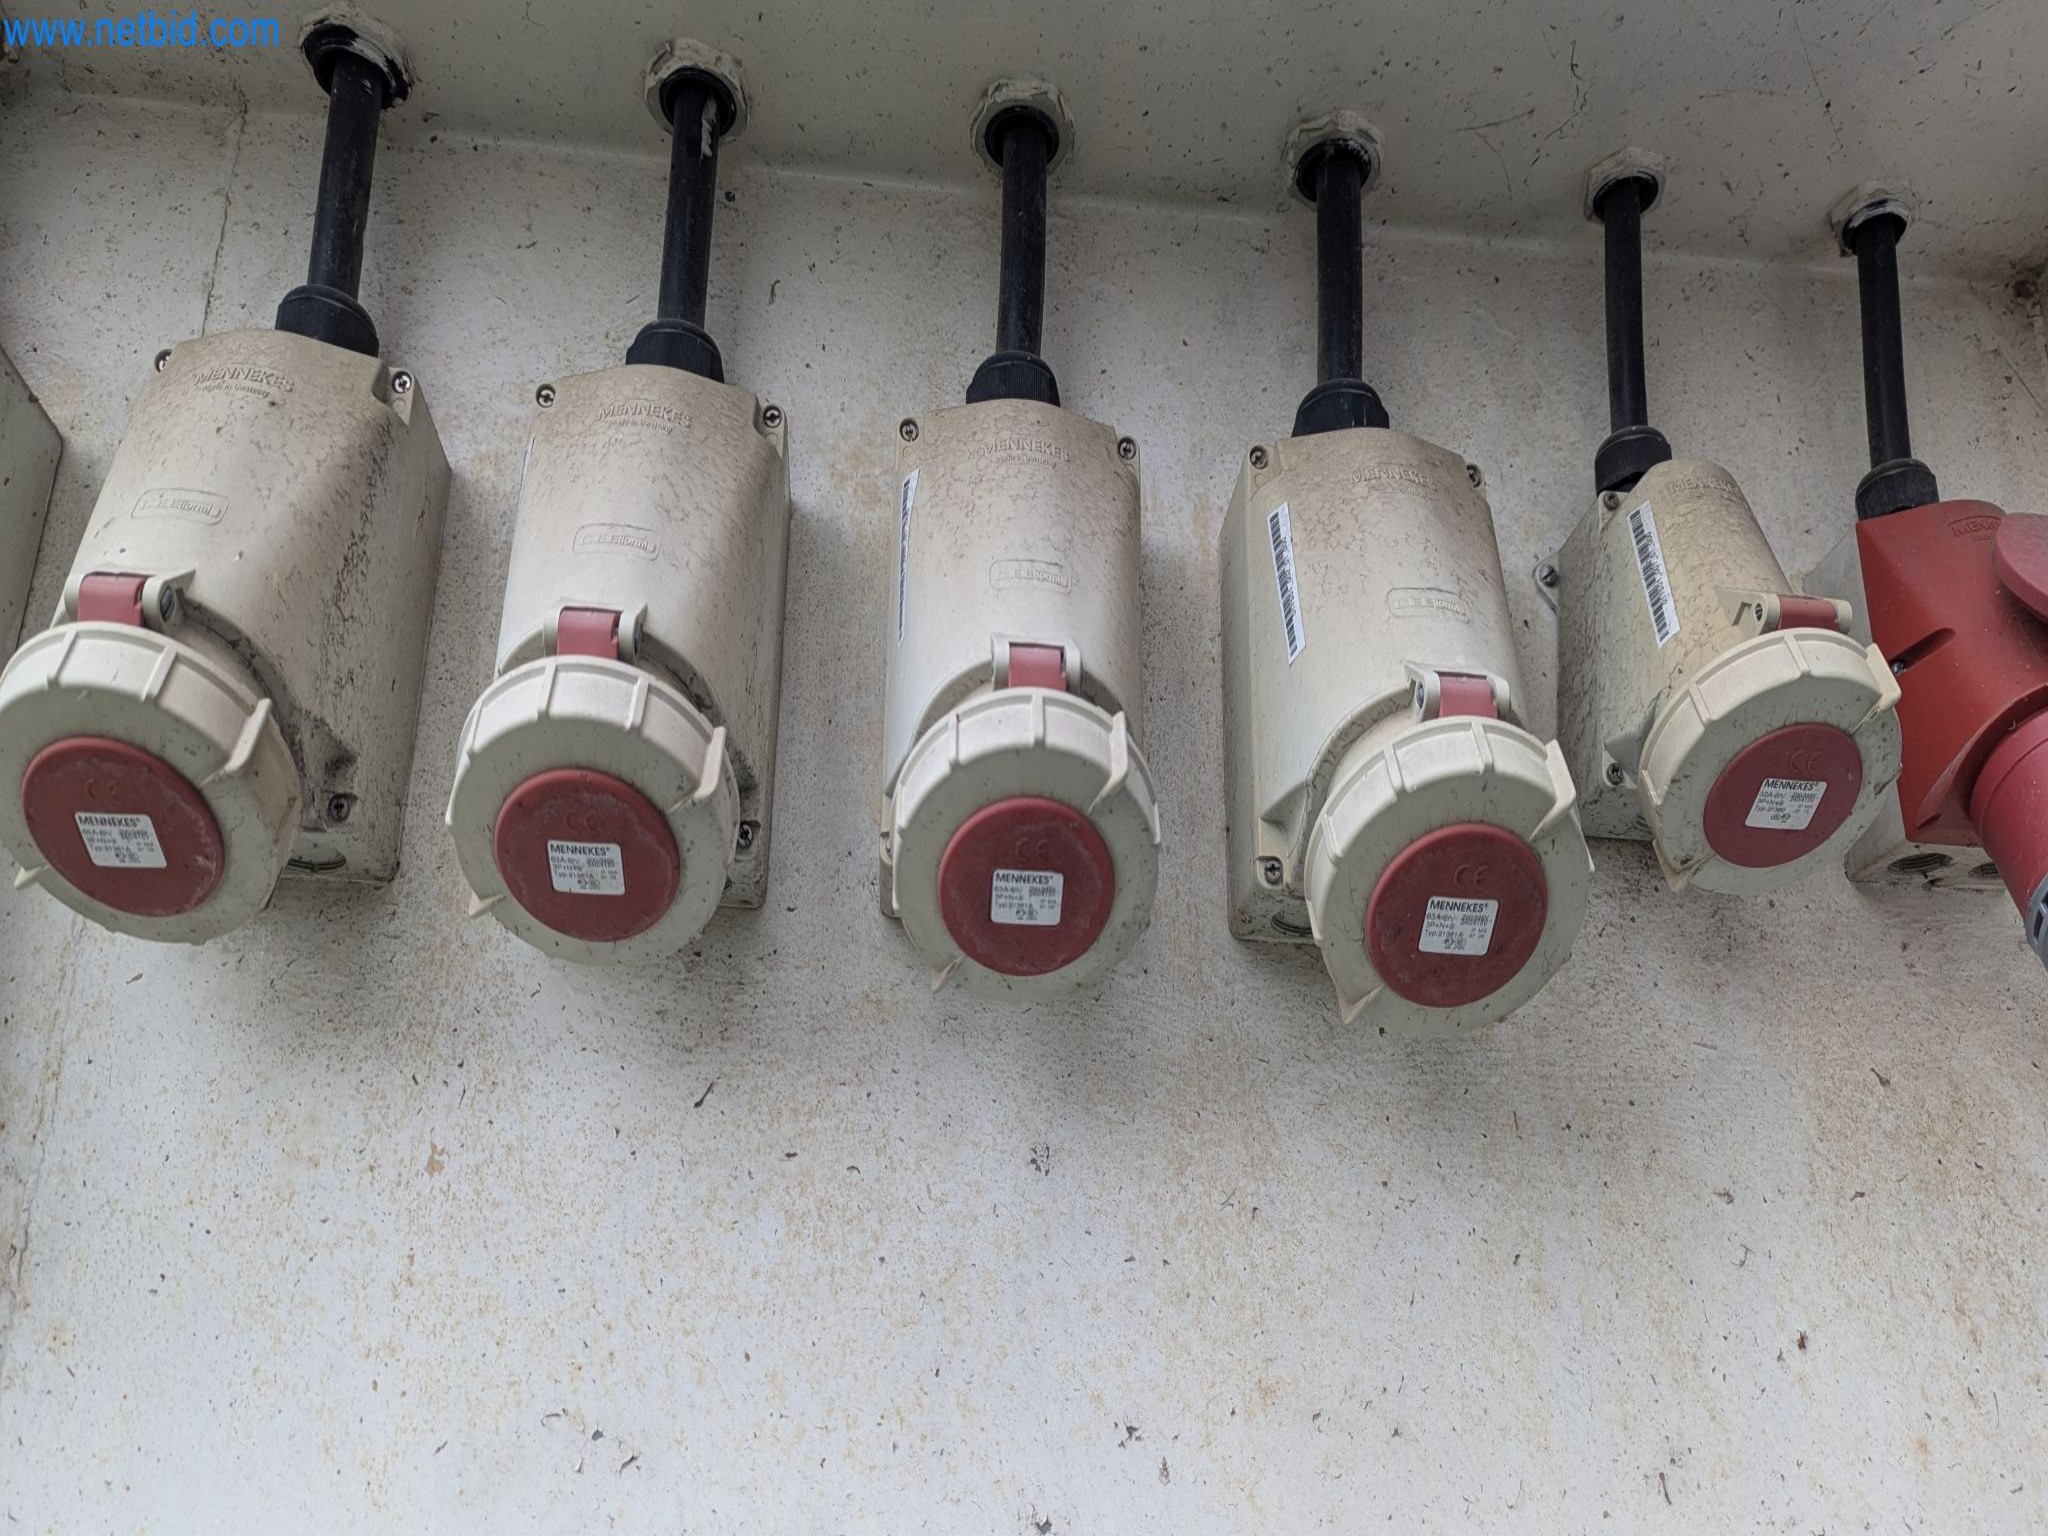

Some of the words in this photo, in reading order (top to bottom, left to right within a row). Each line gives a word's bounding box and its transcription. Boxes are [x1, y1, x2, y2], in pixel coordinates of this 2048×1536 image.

[192, 366, 295, 393] MENNEKES
[599, 401, 694, 429] MENNEKES
[979, 438, 1072, 464] MENNEKES
[1764, 779, 1814, 791] MENNEKES
[550, 844, 607, 857] MENNEKES
[995, 872, 1050, 885] MENNEKES
[1429, 899, 1484, 913] MENNEKES
